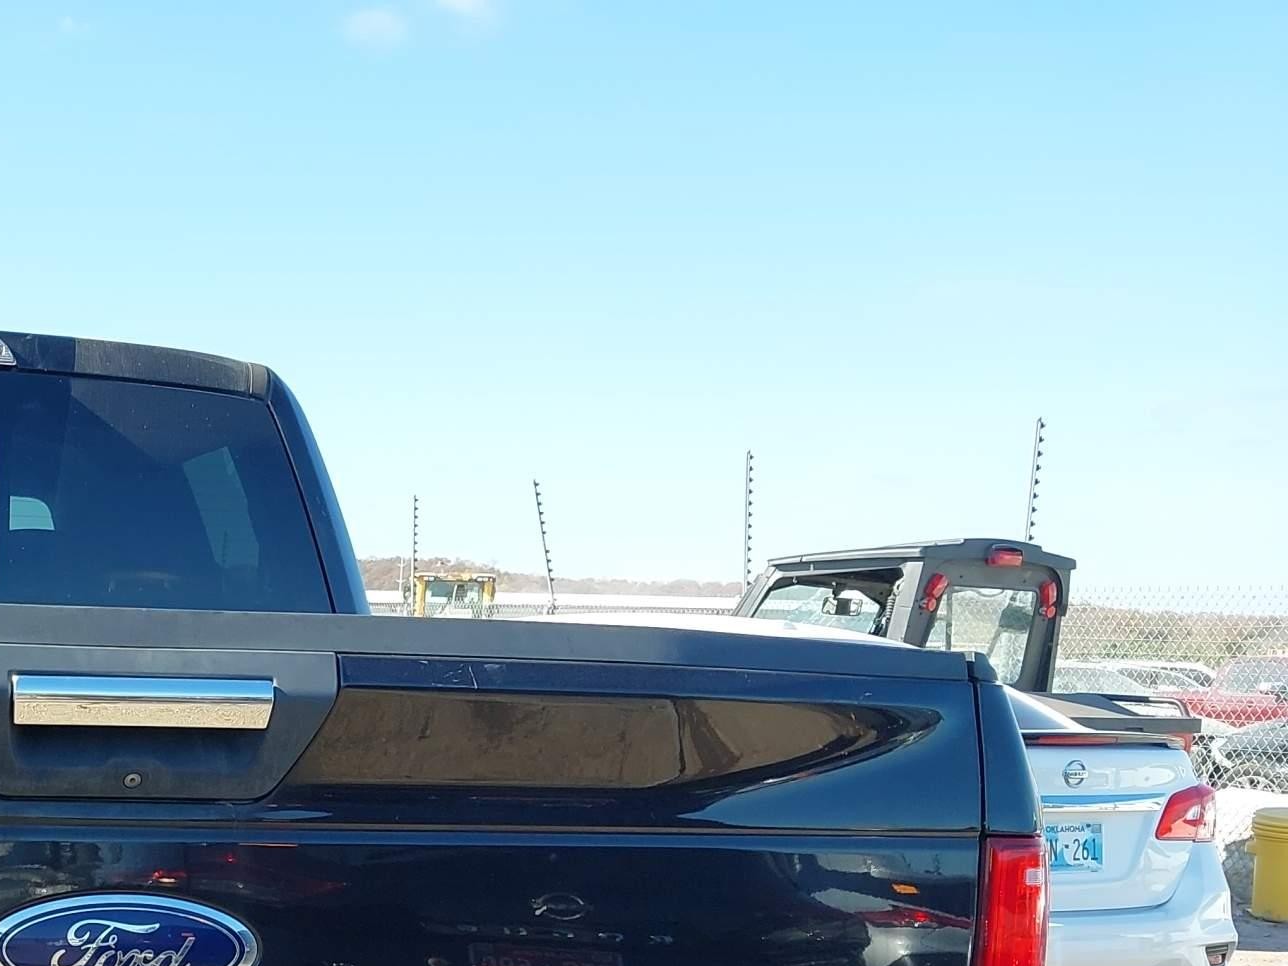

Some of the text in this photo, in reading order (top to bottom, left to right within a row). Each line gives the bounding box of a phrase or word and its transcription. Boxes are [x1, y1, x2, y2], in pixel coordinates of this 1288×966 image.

[1045, 825, 1086, 833] OKLAHOMA
[1047, 838, 1099, 861] N 261
